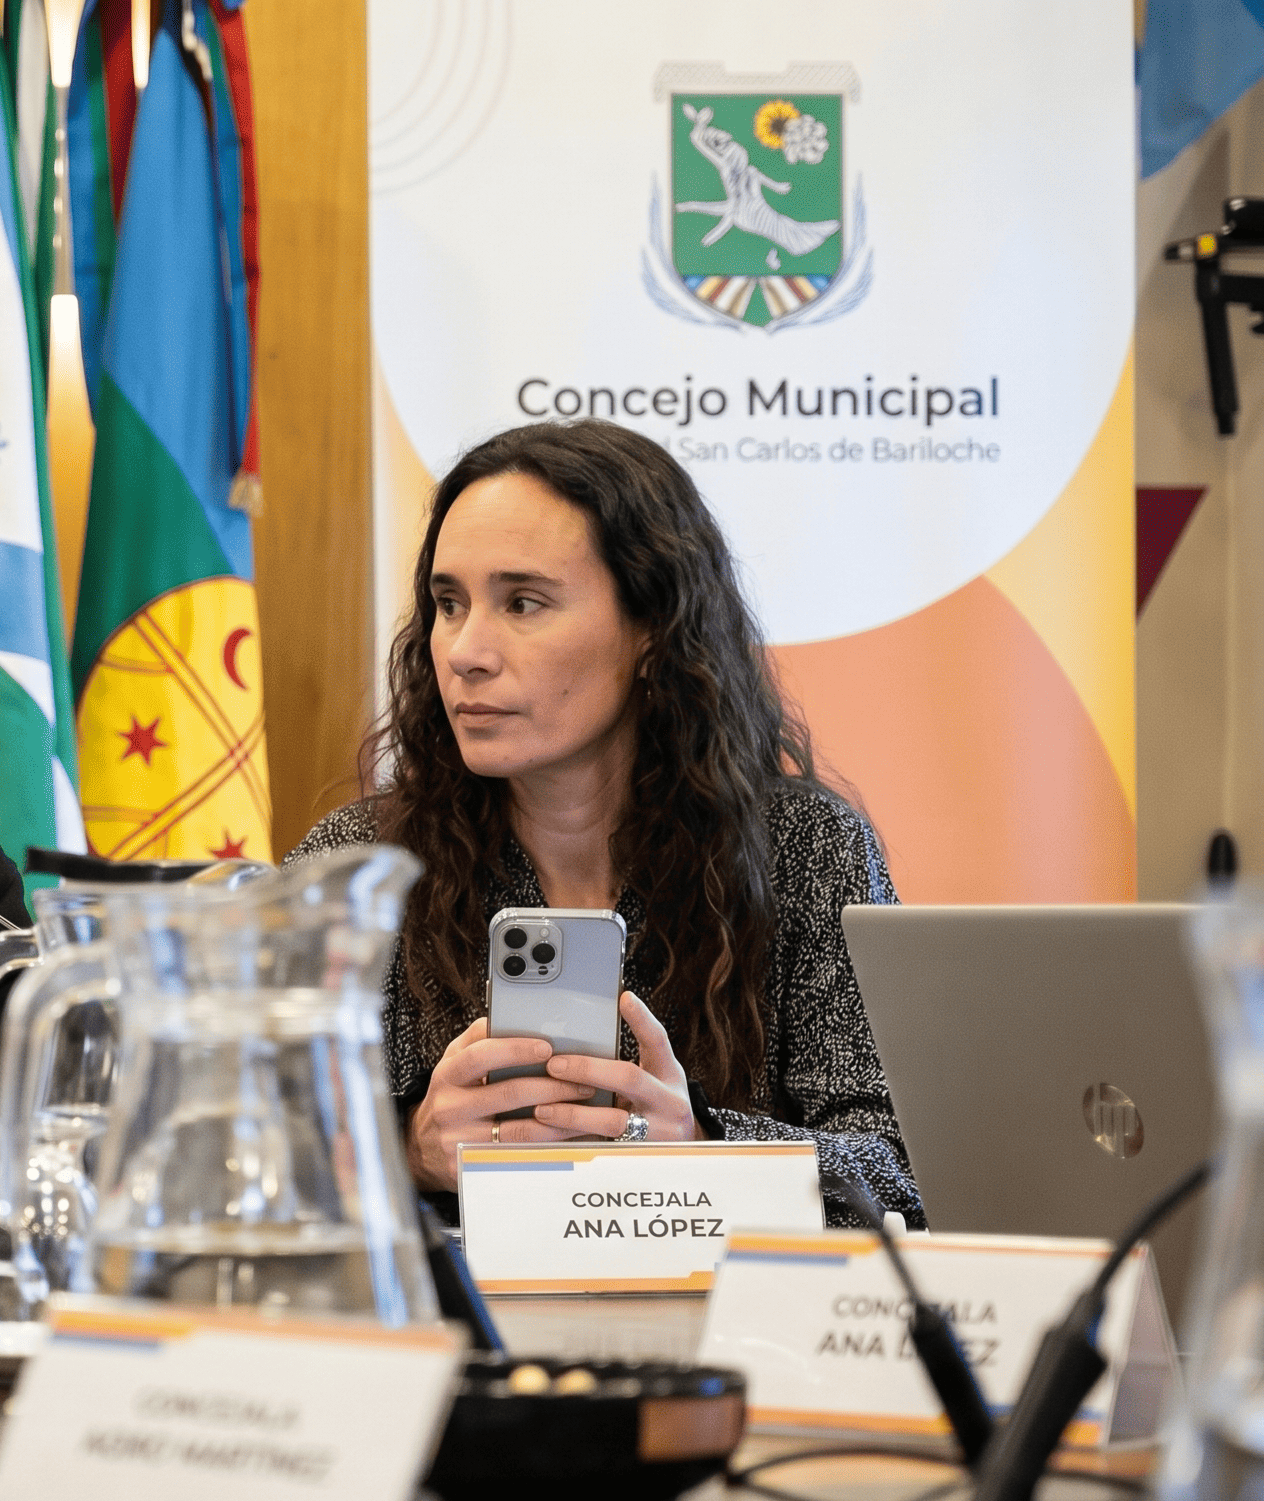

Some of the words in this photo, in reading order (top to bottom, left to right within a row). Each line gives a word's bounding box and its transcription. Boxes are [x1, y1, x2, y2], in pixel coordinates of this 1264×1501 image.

[517, 374, 728, 427] Concejo
[745, 374, 1001, 427] Municipal
[678, 436, 729, 463] San
[735, 436, 822, 464] Carlos
[828, 436, 864, 464] de
[872, 436, 1002, 464] Bariloche
[571, 1191, 712, 1208] CONCEJALA
[563, 1219, 625, 1239] ANA
[634, 1213, 725, 1238] LÓPEZ
[833, 1296, 997, 1323] CONCALA
[818, 1330, 885, 1357] ANA
